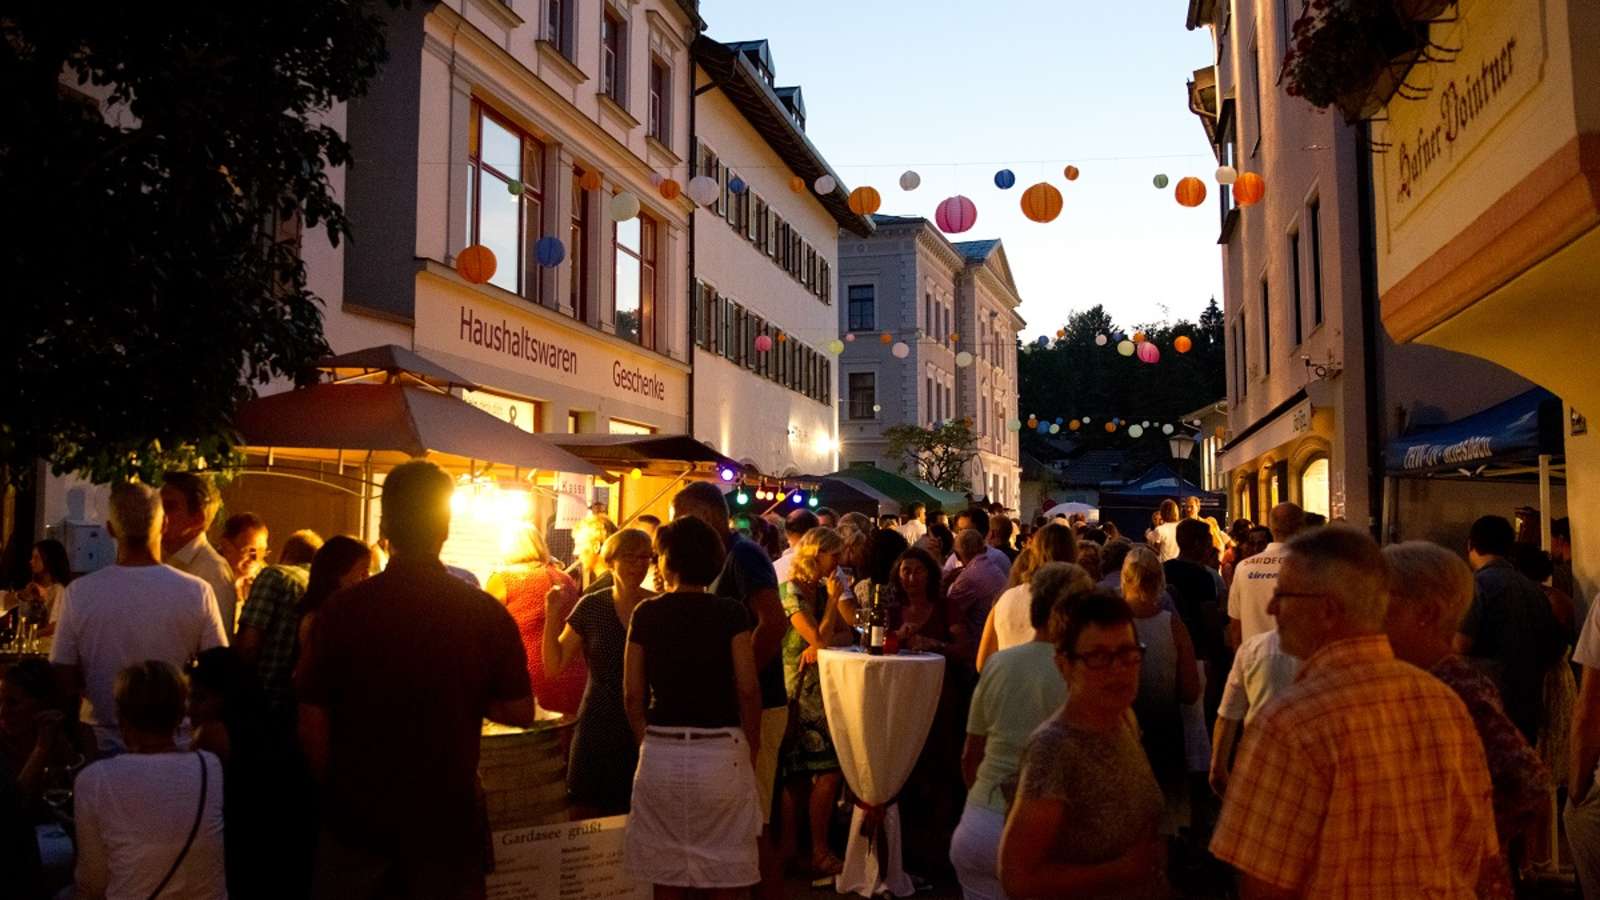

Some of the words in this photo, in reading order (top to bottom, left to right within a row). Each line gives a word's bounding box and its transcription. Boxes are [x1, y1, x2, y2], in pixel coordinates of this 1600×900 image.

[460, 306, 577, 375] Haushaltswaren
[612, 360, 664, 401] Geschenke
[502, 829, 562, 846] Gardasee
